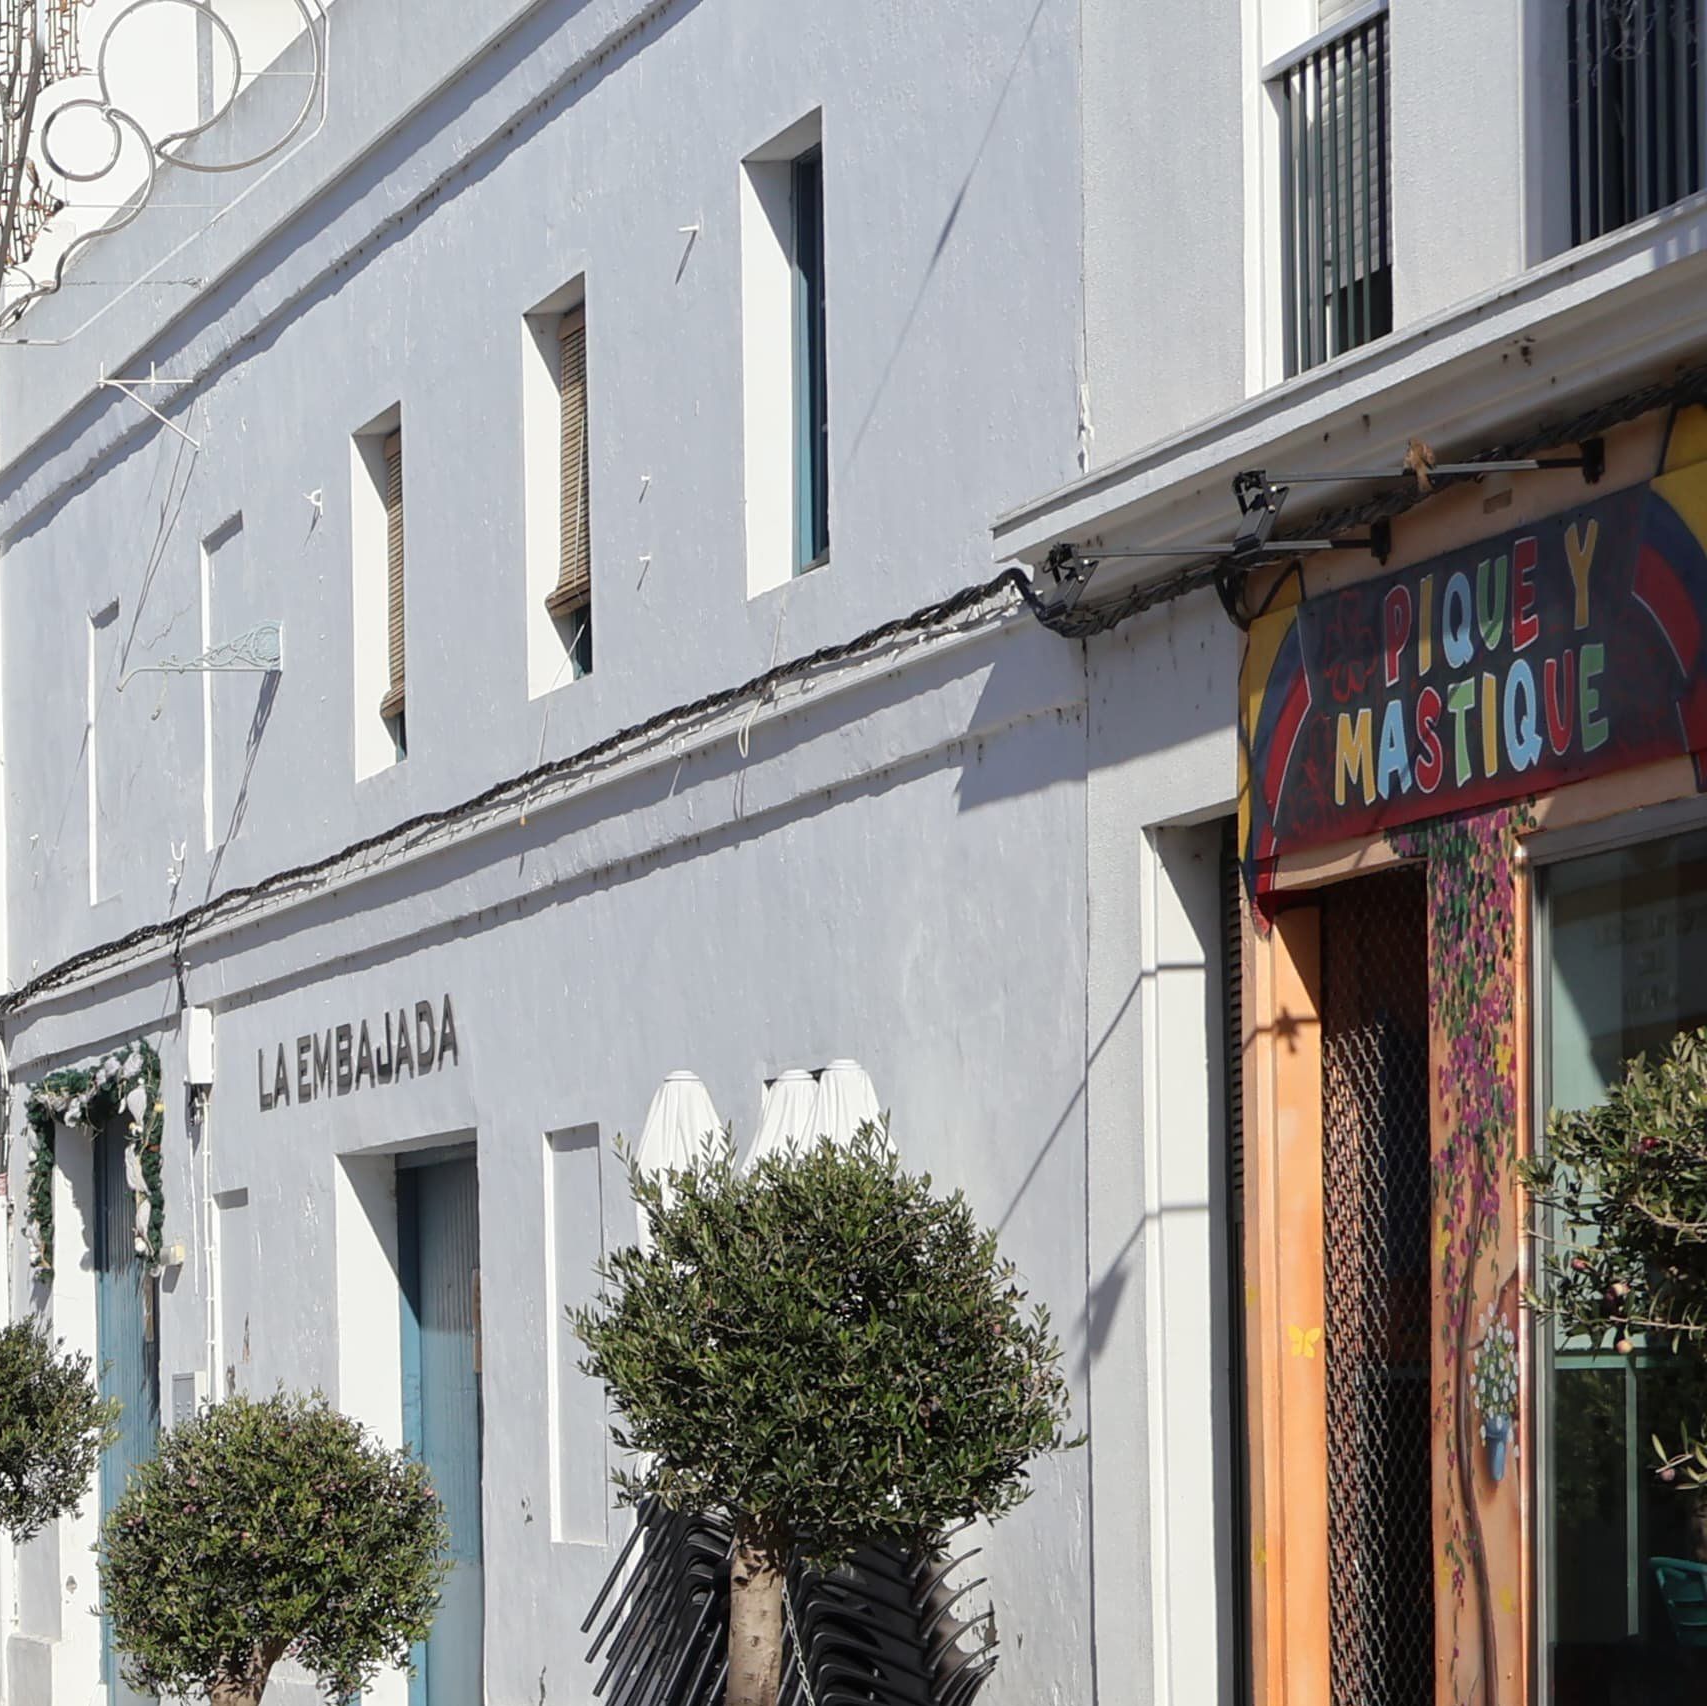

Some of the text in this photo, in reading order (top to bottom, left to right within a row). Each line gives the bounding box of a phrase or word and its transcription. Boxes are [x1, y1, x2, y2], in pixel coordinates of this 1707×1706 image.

[1384, 517, 1600, 689] PIQUE Y
[1334, 642, 1610, 807] MASTIQUE
[258, 992, 459, 1113] LA EMBAJADA
